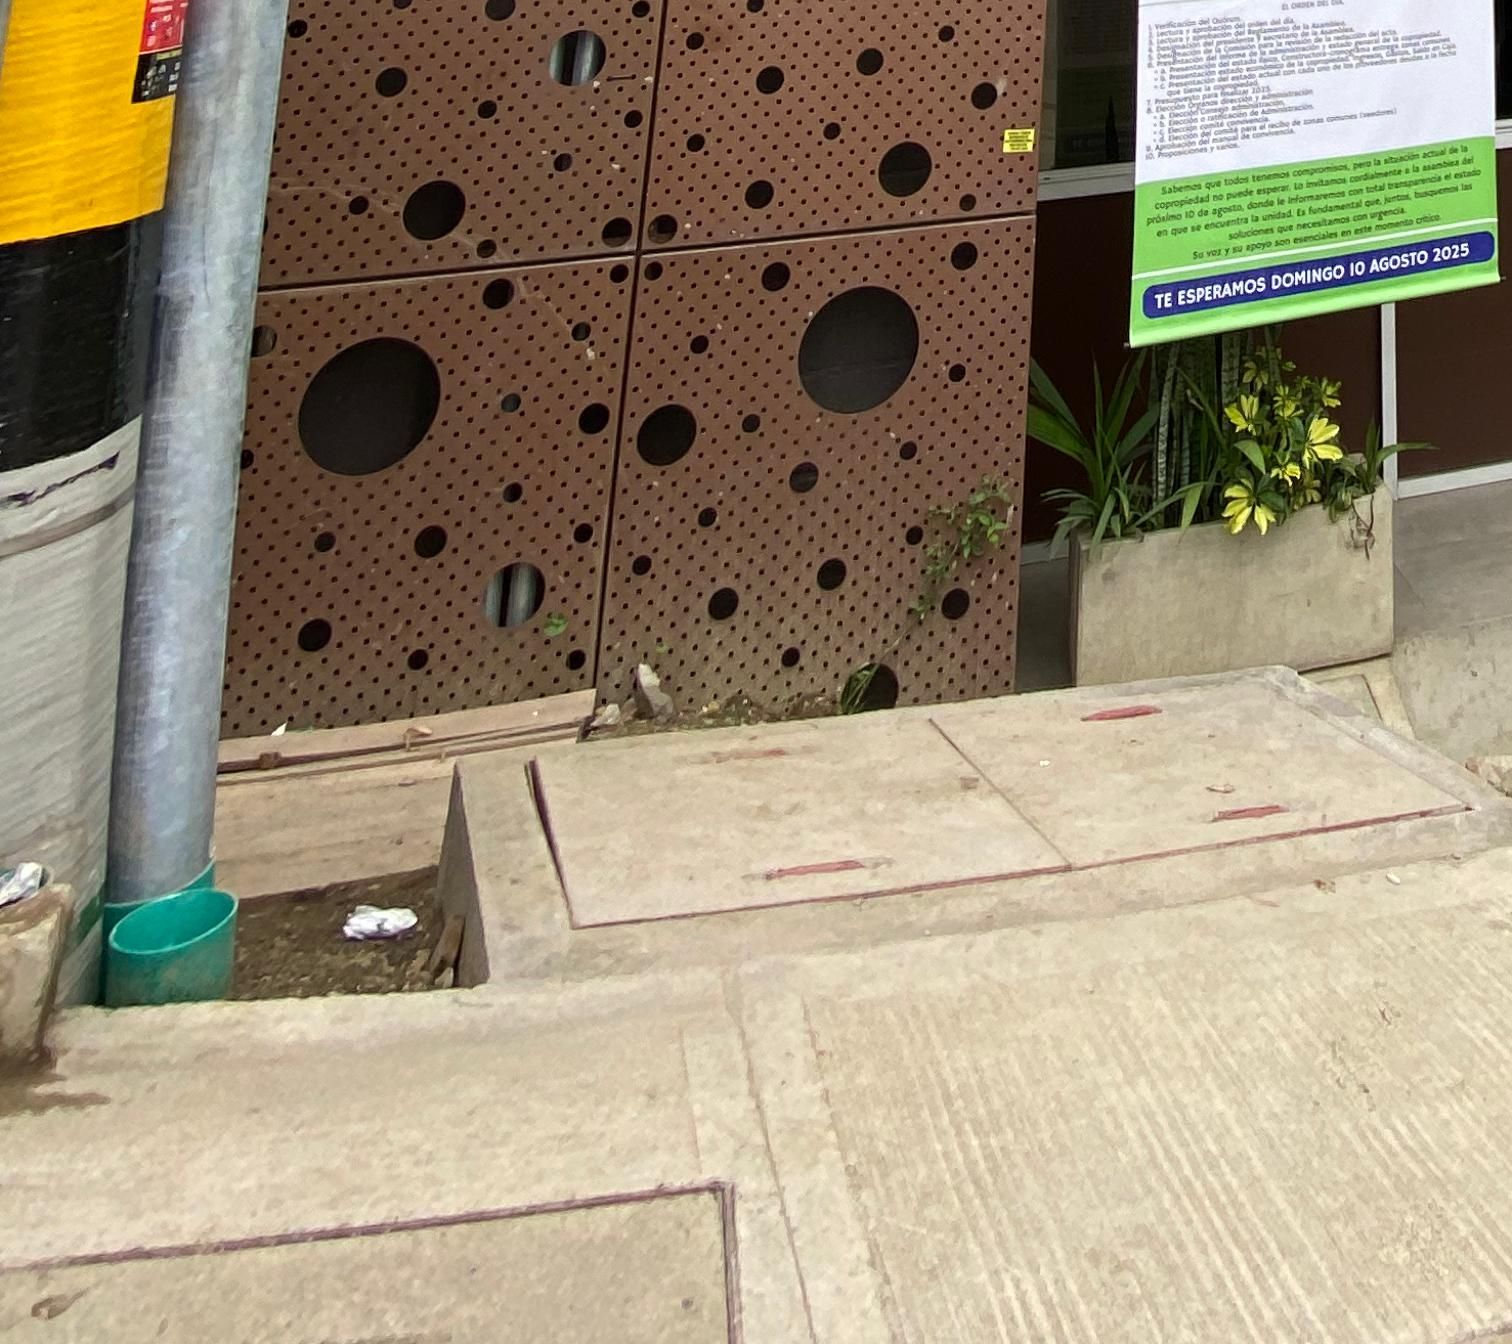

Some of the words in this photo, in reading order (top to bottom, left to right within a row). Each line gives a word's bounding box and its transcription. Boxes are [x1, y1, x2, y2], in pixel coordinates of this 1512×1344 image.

[1153, 291, 1172, 309] TE
[1177, 276, 1266, 306] ESPERAMOS
[1270, 264, 1345, 290] DOMINGO
[1349, 260, 1366, 277] 10
[1368, 249, 1429, 274] AGOSTO
[1431, 242, 1470, 262] 2025
